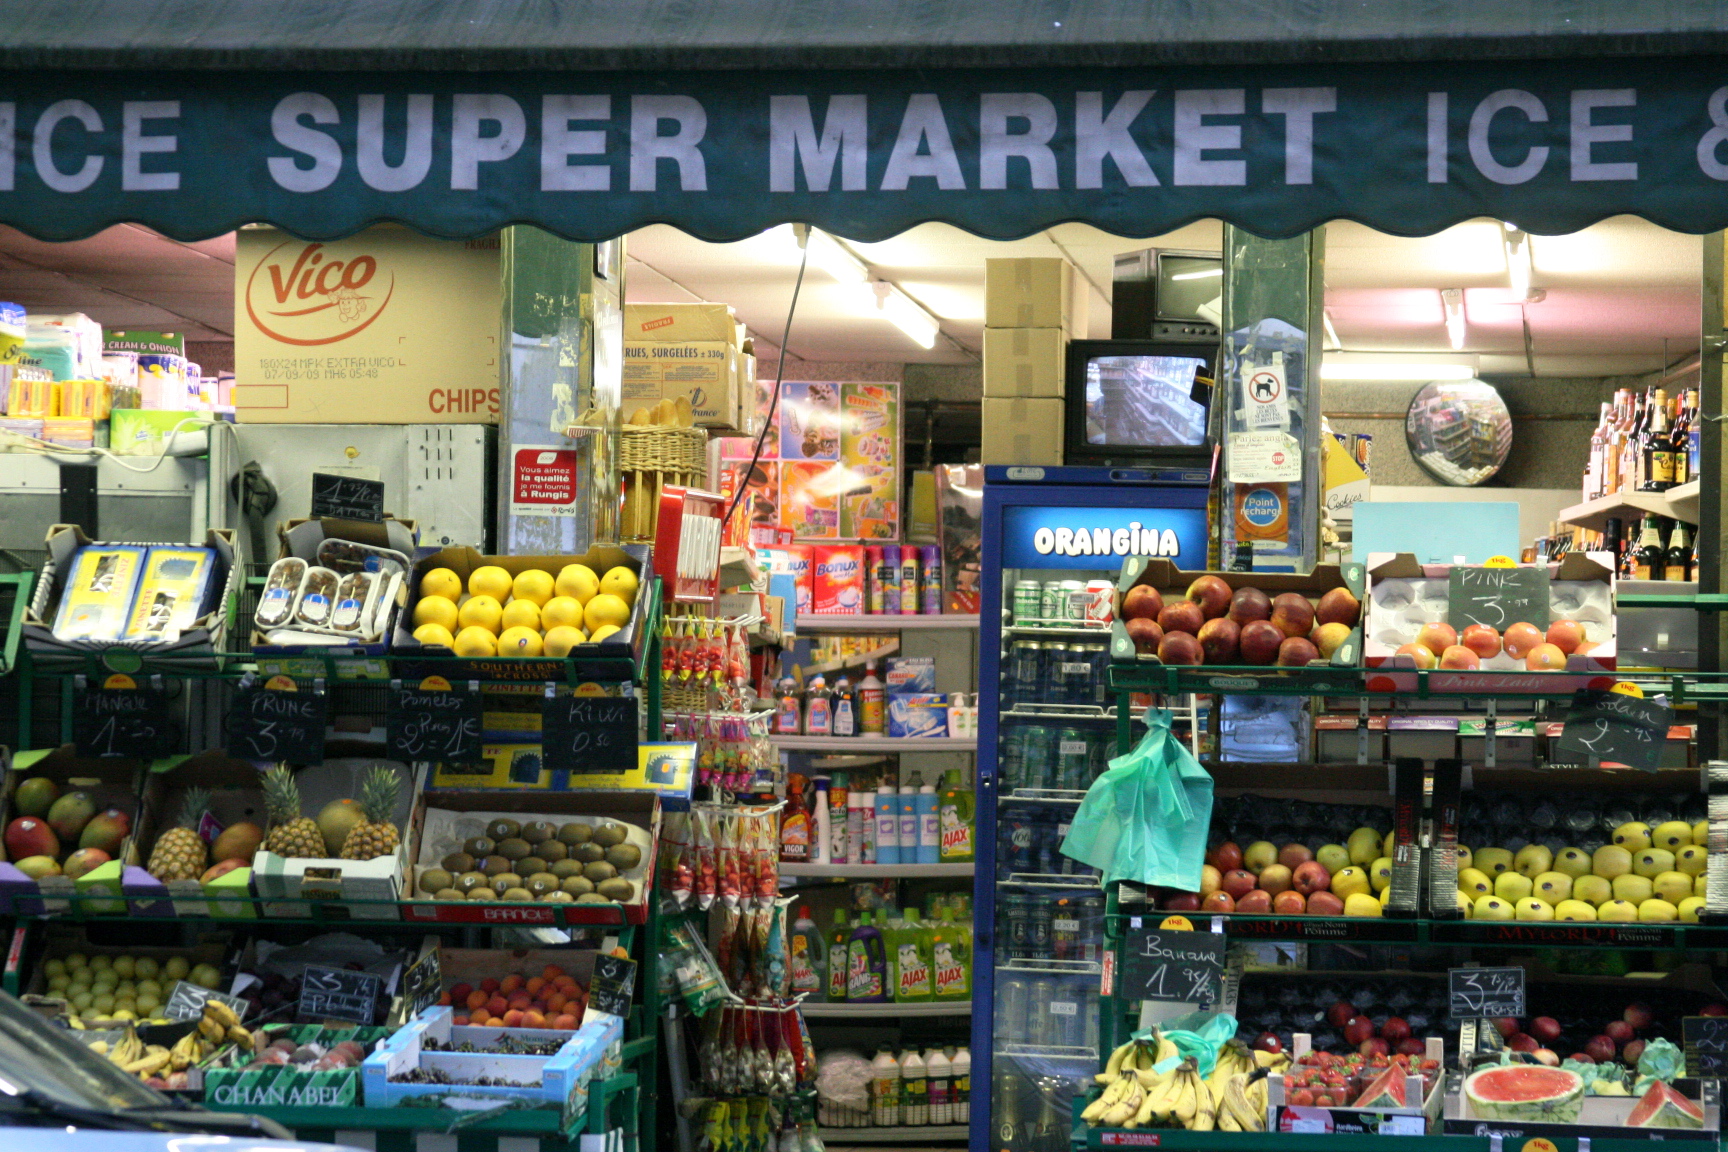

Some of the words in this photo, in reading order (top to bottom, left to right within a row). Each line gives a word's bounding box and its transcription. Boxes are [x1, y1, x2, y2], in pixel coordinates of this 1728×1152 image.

[266, 93, 708, 195] SUPER
[770, 87, 1337, 192] MARKET
[1427, 88, 1638, 184] ICE
[268, 243, 376, 304] Vico
[108, 340, 138, 350] CREAM
[140, 342, 147, 350] &
[149, 342, 180, 355] ONION
[651, 345, 698, 358] SURGELÉES
[707, 349, 725, 360] 330g
[326, 356, 366, 368] EXTRA
[369, 356, 395, 368] VICO
[264, 369, 320, 380] 07/09/09
[324, 369, 347, 379] MH6
[349, 368, 379, 379] 05:48
[428, 388, 499, 414] CHIPS
[534, 475, 570, 483] qualité
[520, 490, 528, 498] à
[531, 490, 569, 500] Rungis
[1249, 498, 1274, 506] Point
[1327, 493, 1363, 510] Cookies
[1240, 507, 1282, 517] recharge
[817, 560, 859, 576] Bonux
[1461, 568, 1521, 588] PINK
[470, 661, 558, 671] SOUTHERN
[1063, 663, 1082, 672] 1,80
[488, 684, 542, 692] ZINETTE
[1437, 675, 1487, 688] Pink
[1491, 676, 1545, 689] Lady
[1620, 682, 1635, 692] 1kg
[251, 692, 317, 718] PRUNE
[942, 827, 968, 847] AJAX
[784, 844, 804, 853] VIGOR
[1140, 935, 1224, 967] Banane
[902, 968, 927, 987] AJAX
[937, 966, 962, 985] AJAX
[214, 1085, 345, 1106] CHANABEL
[1533, 1140, 1549, 1150] 1kg
